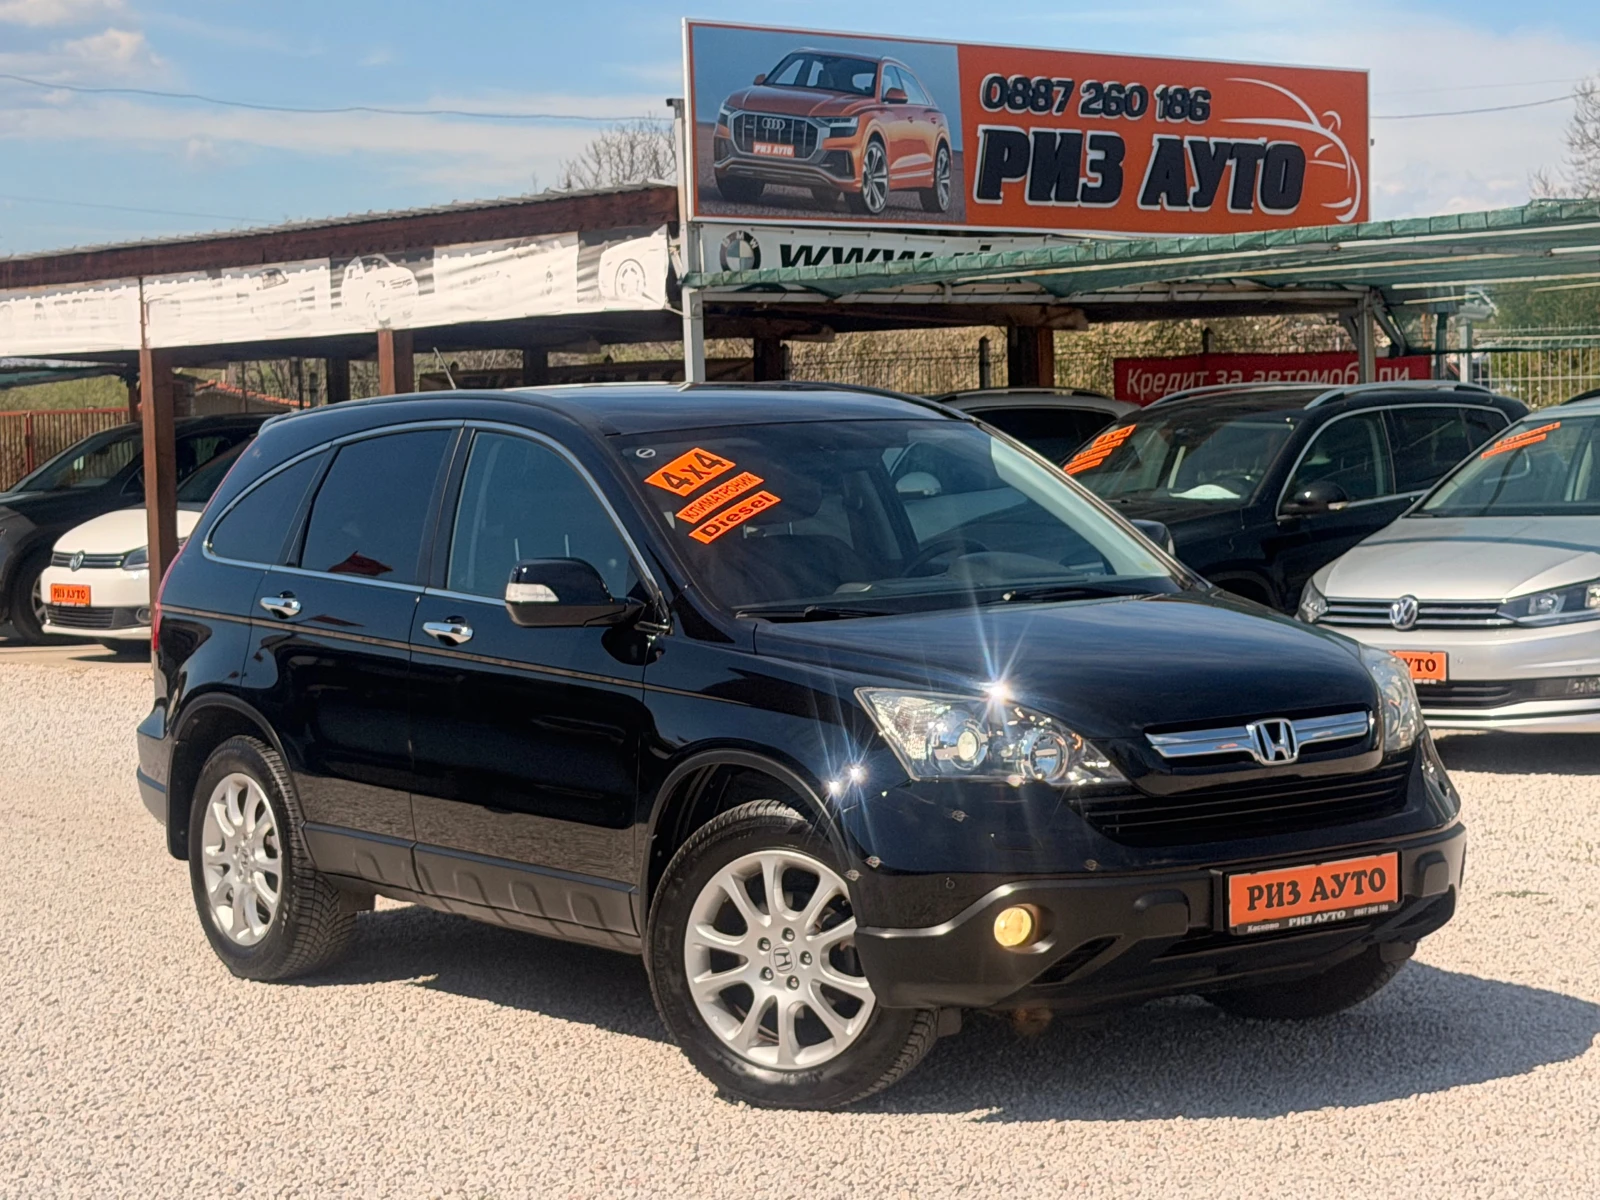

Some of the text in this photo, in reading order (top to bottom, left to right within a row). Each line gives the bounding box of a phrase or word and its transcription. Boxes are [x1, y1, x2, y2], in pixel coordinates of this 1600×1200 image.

[980, 73, 1212, 123] 0887 260 186
[974, 125, 1306, 215] РИЗ АУТО
[1126, 368, 1209, 397] Кредит
[683, 474, 757, 520] КЛИМАТРОНИК
[700, 494, 773, 537] Diesel
[1247, 867, 1386, 911] РИЗ АУТО
[1288, 915, 1313, 927] РИЗ
[1314, 909, 1347, 924] АУТО
